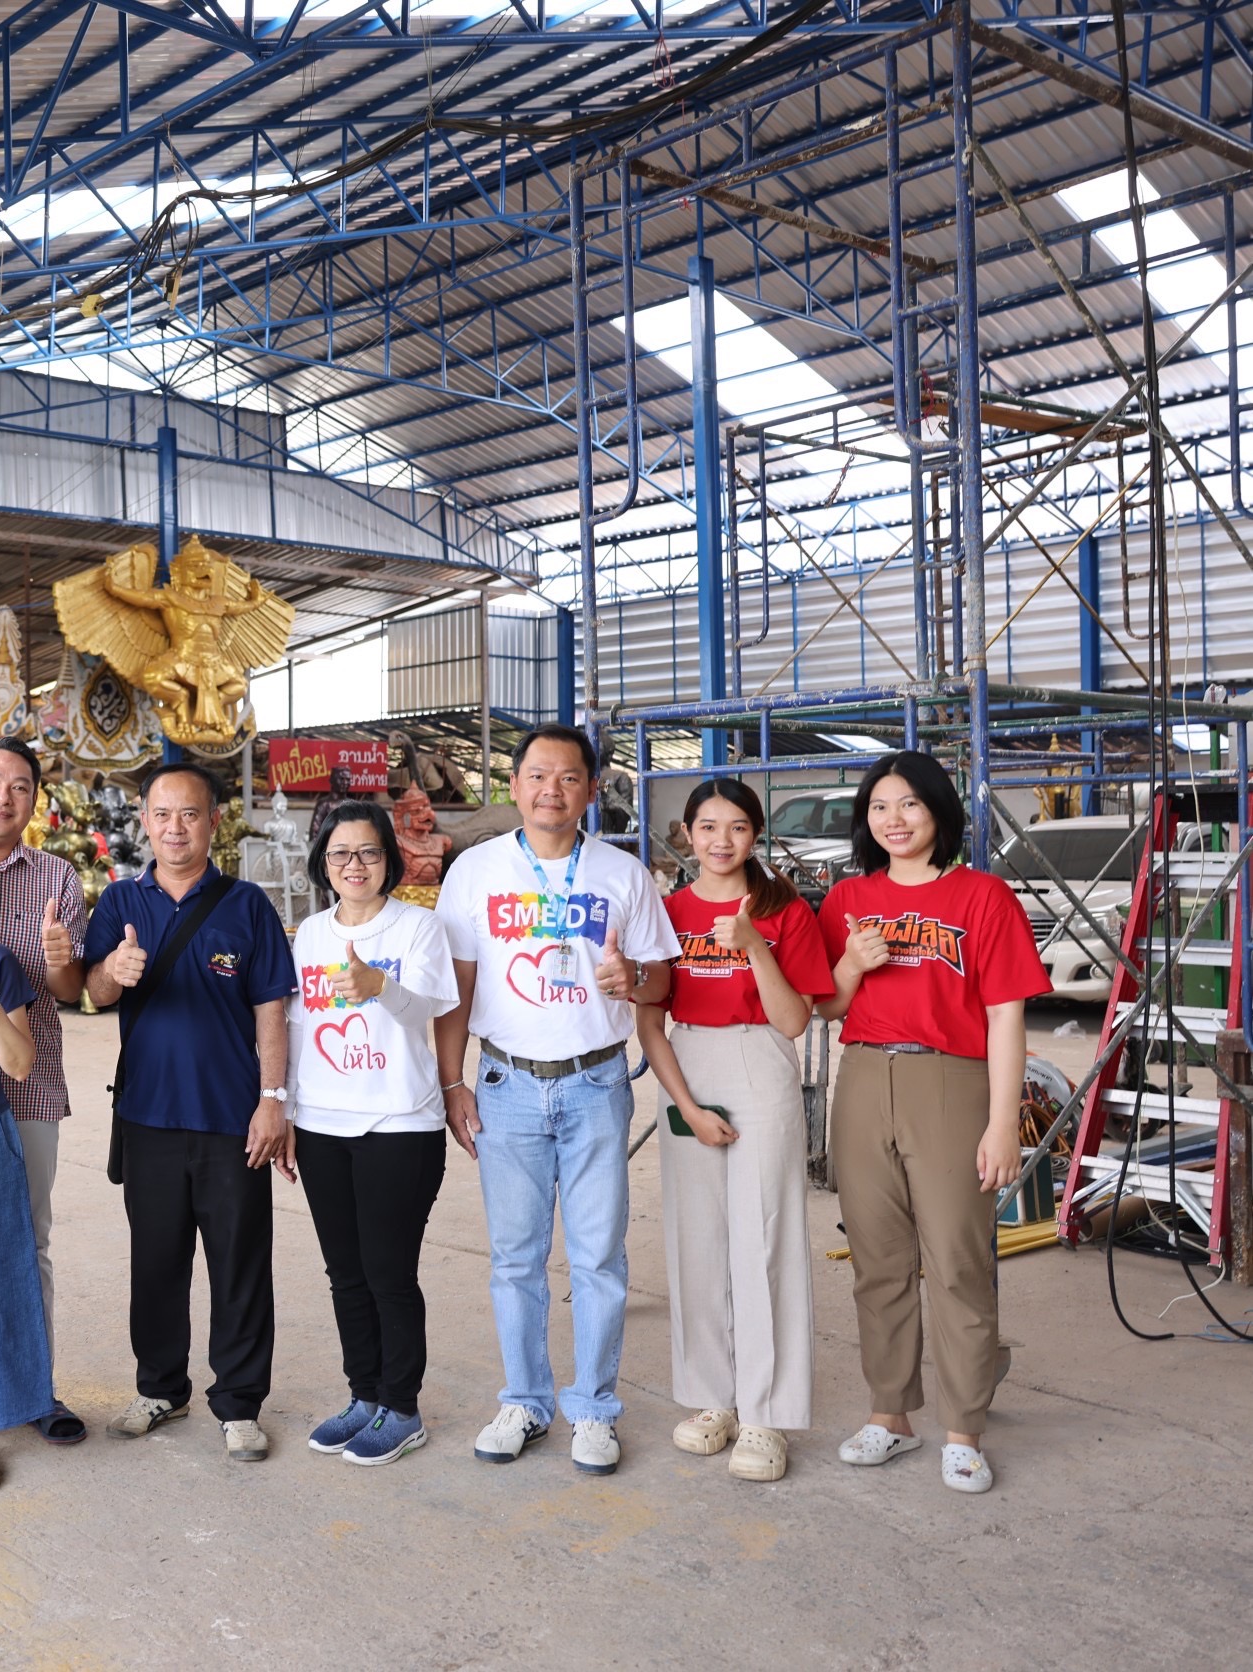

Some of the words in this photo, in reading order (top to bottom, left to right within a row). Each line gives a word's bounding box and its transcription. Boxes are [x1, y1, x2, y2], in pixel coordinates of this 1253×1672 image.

[498, 903, 557, 929] SME
[566, 903, 587, 929] D
[343, 1044, 387, 1070] ให้ใจ
